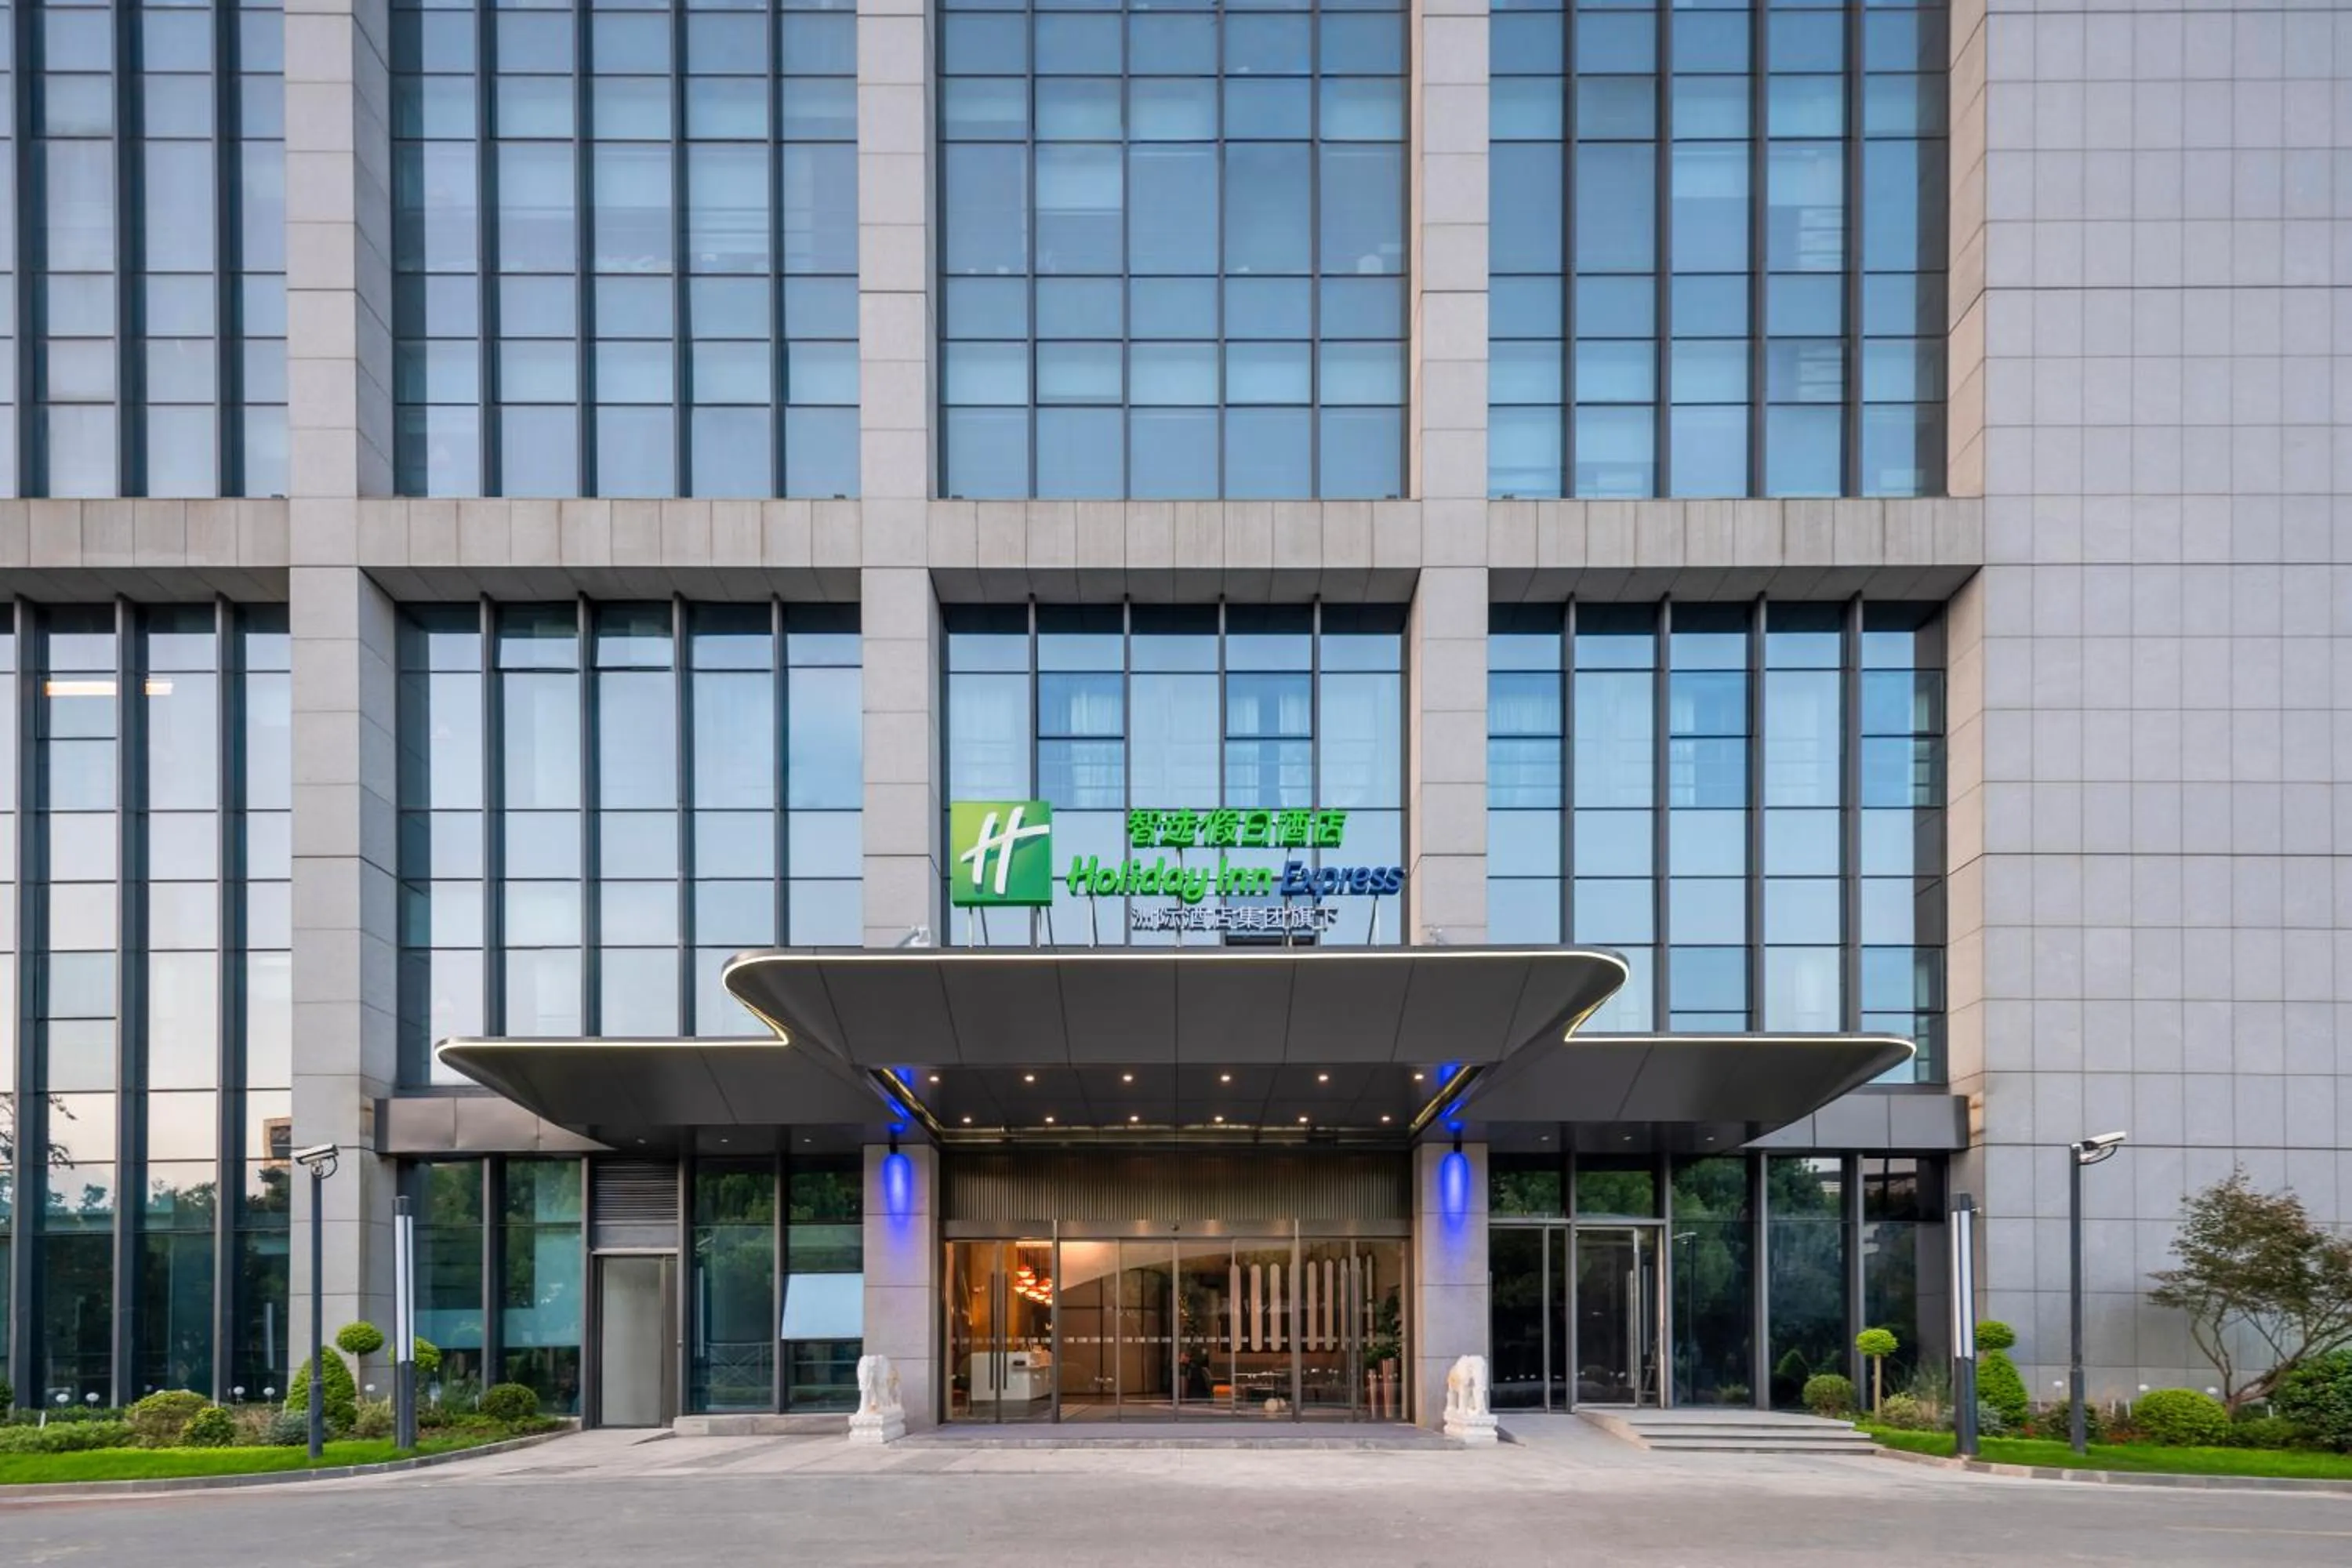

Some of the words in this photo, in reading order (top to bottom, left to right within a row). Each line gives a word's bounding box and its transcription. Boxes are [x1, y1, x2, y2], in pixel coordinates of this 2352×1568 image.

[1128, 808, 1348, 848] 智选假日酒店
[1066, 855, 1209, 903] Holiday
[1216, 855, 1272, 896] Inn
[1280, 861, 1404, 903] Express
